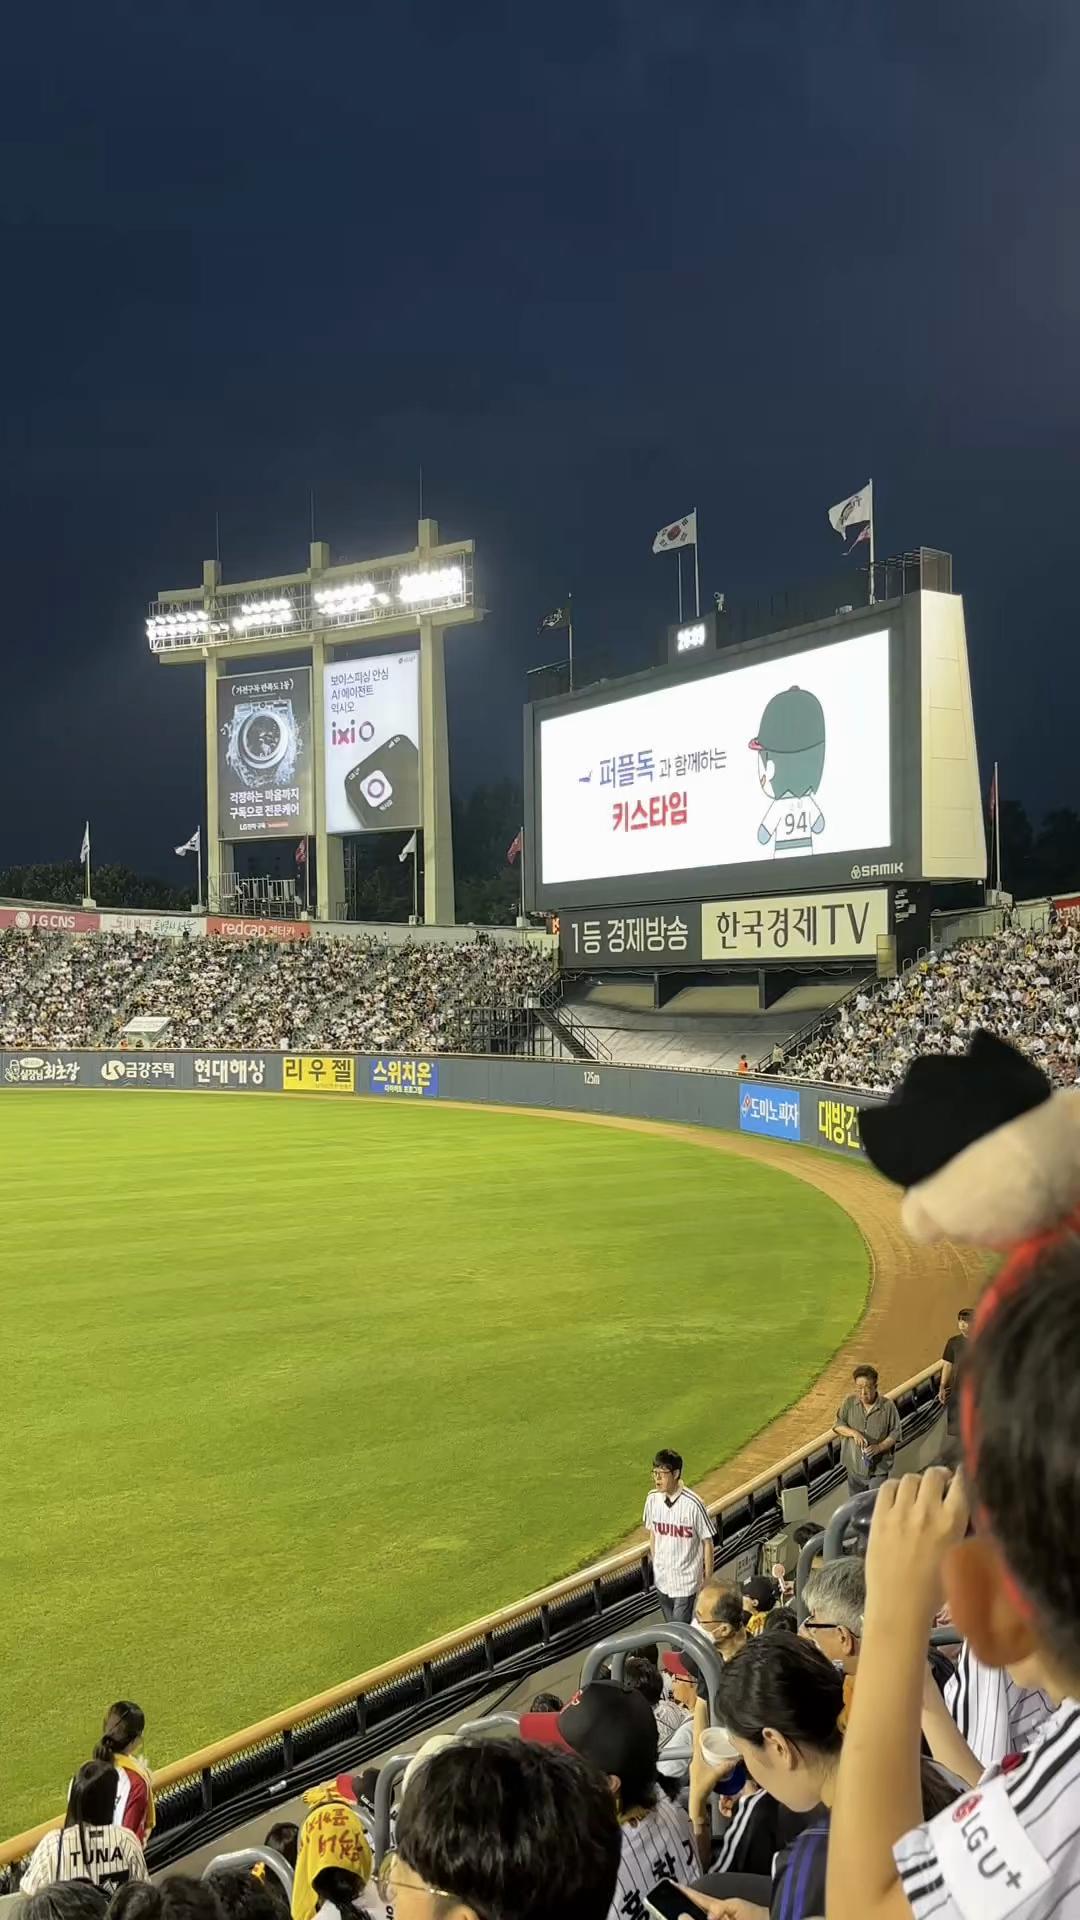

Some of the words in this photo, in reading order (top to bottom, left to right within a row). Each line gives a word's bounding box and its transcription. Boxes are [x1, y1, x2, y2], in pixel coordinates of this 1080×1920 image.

[331, 671, 371, 686] 보이스피싱
[372, 667, 389, 681] 안심
[331, 689, 341, 700] AI
[341, 685, 374, 700] 에이전트
[330, 701, 355, 715] 익시오
[599, 749, 655, 788] 퍼플독
[658, 758, 672, 778] 과
[674, 747, 728, 777] 함께하는
[230, 790, 264, 804] 걱정하는
[265, 787, 300, 801] 마음까지
[229, 806, 264, 819] 구독으로
[265, 803, 300, 817] 전문케어
[611, 791, 688, 833] 키스타임
[784, 811, 808, 836] 94
[861, 862, 904, 877] SAMIK
[50, 915, 76, 928] CNS
[221, 920, 267, 938] redcap
[715, 902, 870, 950] 한국경제TV
[571, 919, 602, 955] 1등
[606, 915, 689, 953] 경제방송
[125, 1062, 176, 1079] 금강주택
[194, 1058, 266, 1085] 현대해상
[286, 1059, 352, 1083] 리우젤
[373, 1060, 432, 1087] 스위치온
[584, 1071, 600, 1085] 125m
[751, 1098, 799, 1128] 도미노피자
[652, 1521, 693, 1538] TWINS
[70, 1846, 123, 1867] TUNA
